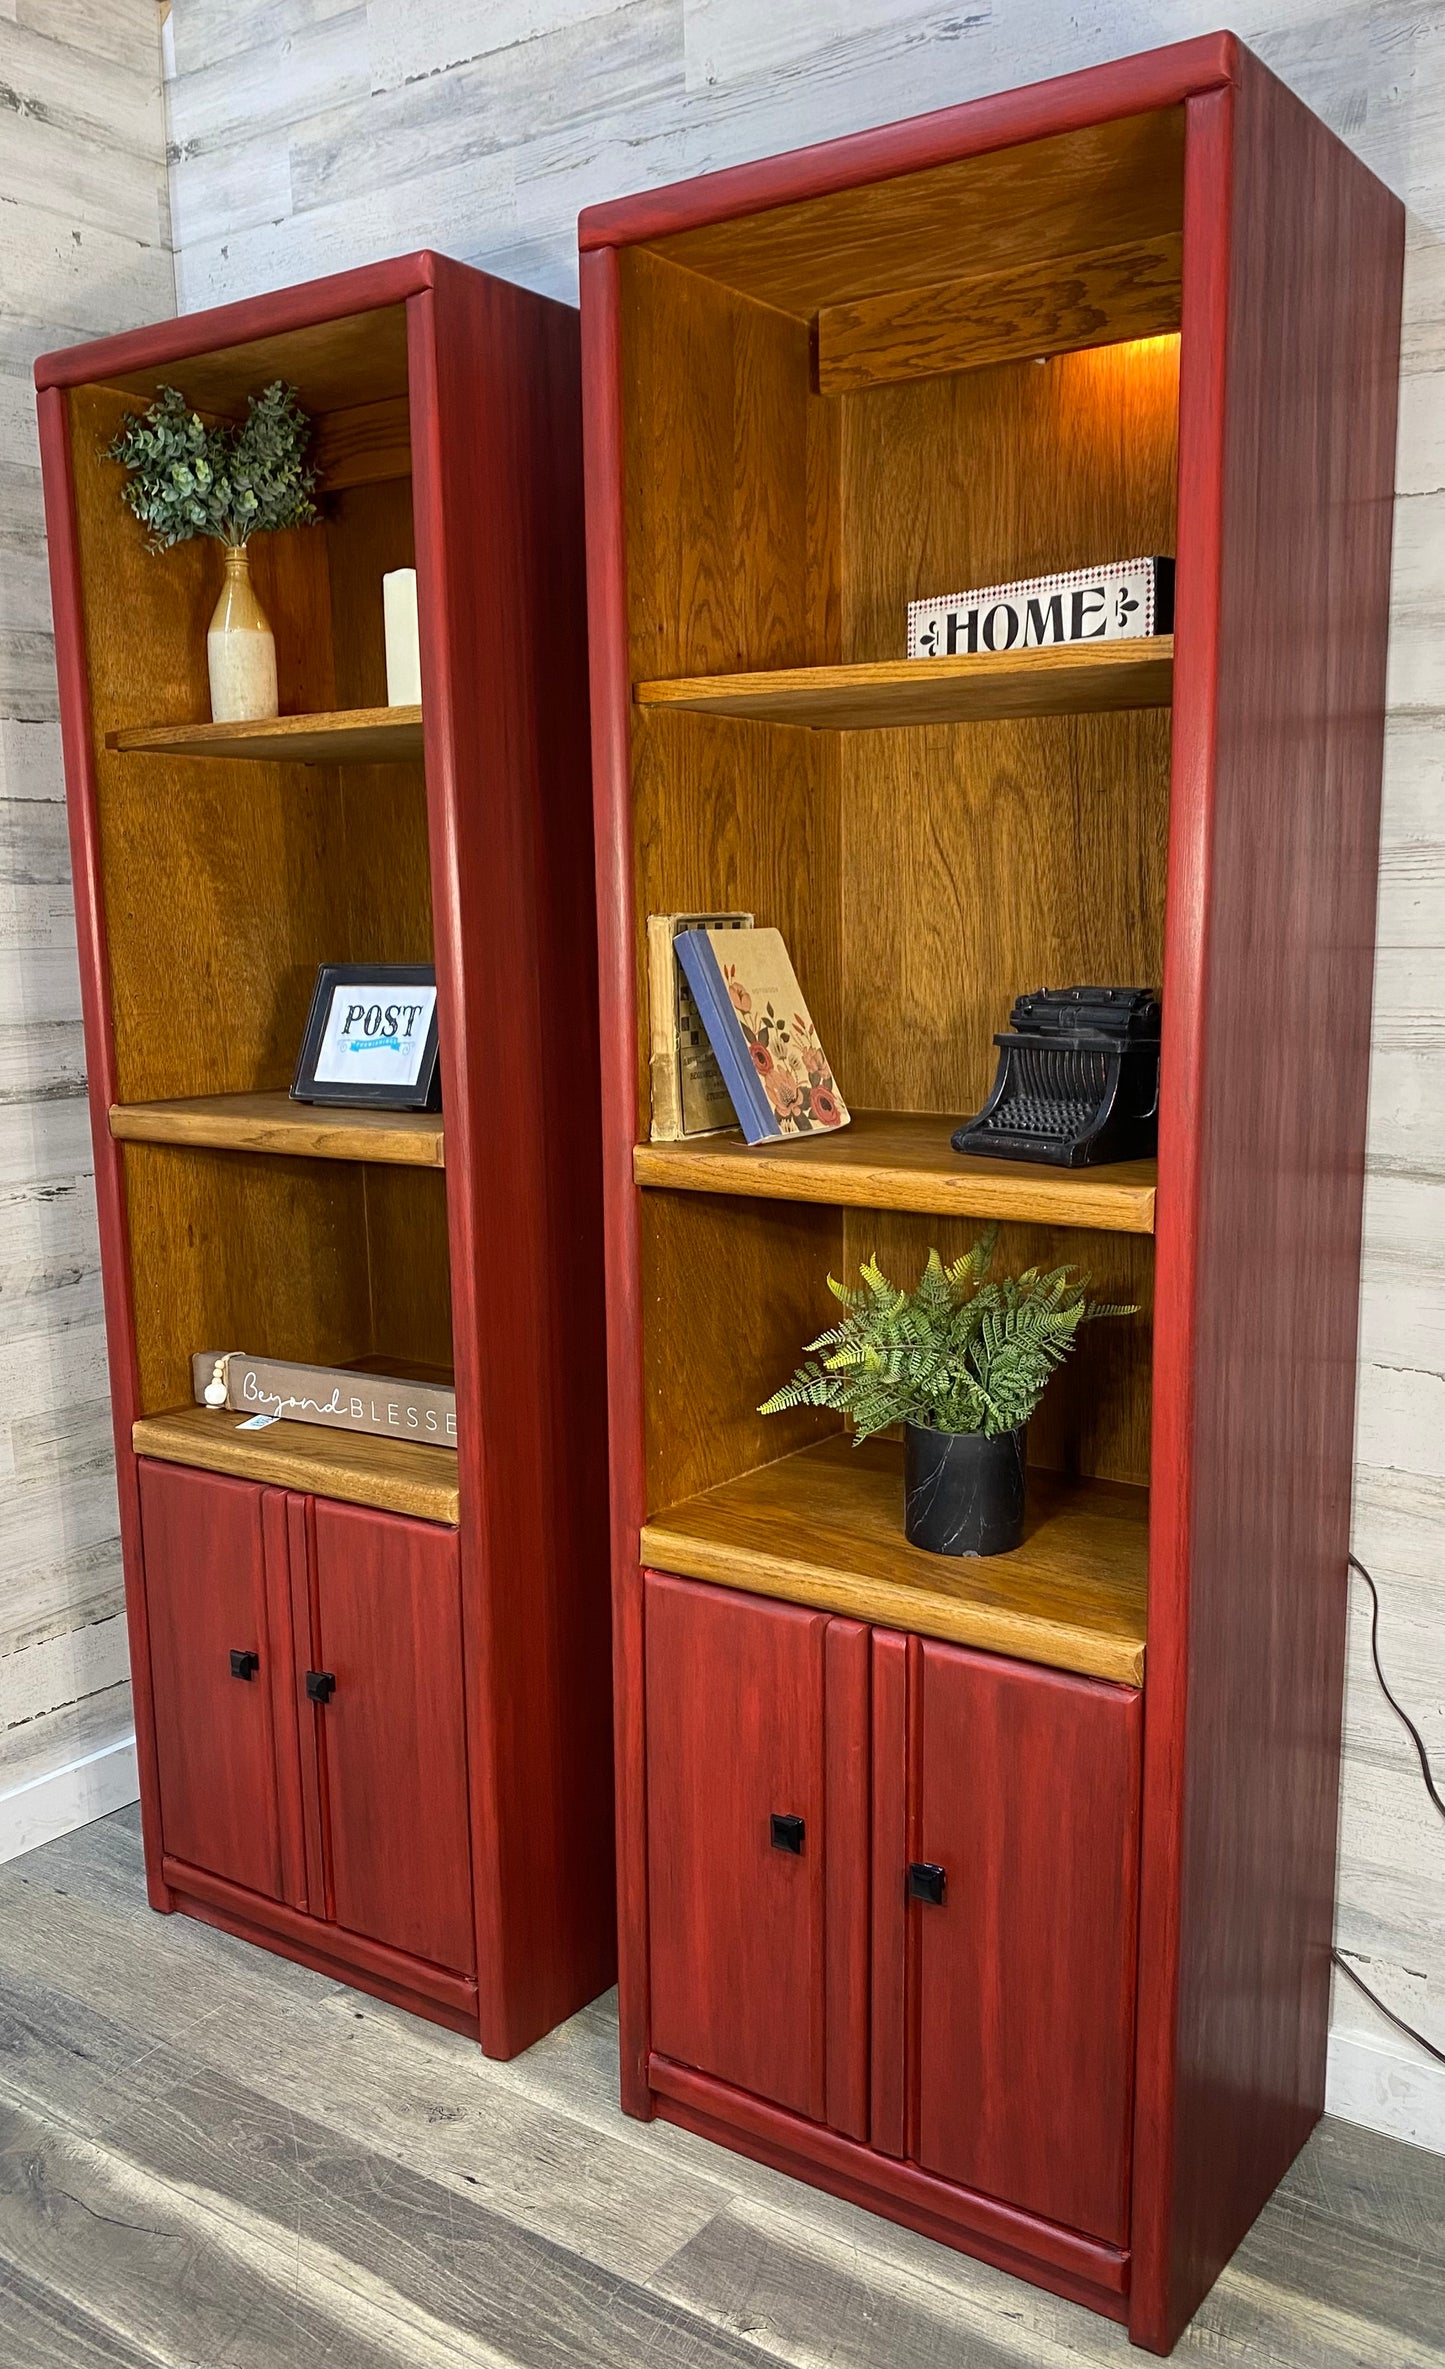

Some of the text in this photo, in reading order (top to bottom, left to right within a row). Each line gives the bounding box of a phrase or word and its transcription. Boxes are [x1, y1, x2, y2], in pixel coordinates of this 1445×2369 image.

[946, 586, 1108, 655] HOME
[341, 1004, 424, 1037] POST
[243, 1371, 458, 1435] Beyond BLESSE
